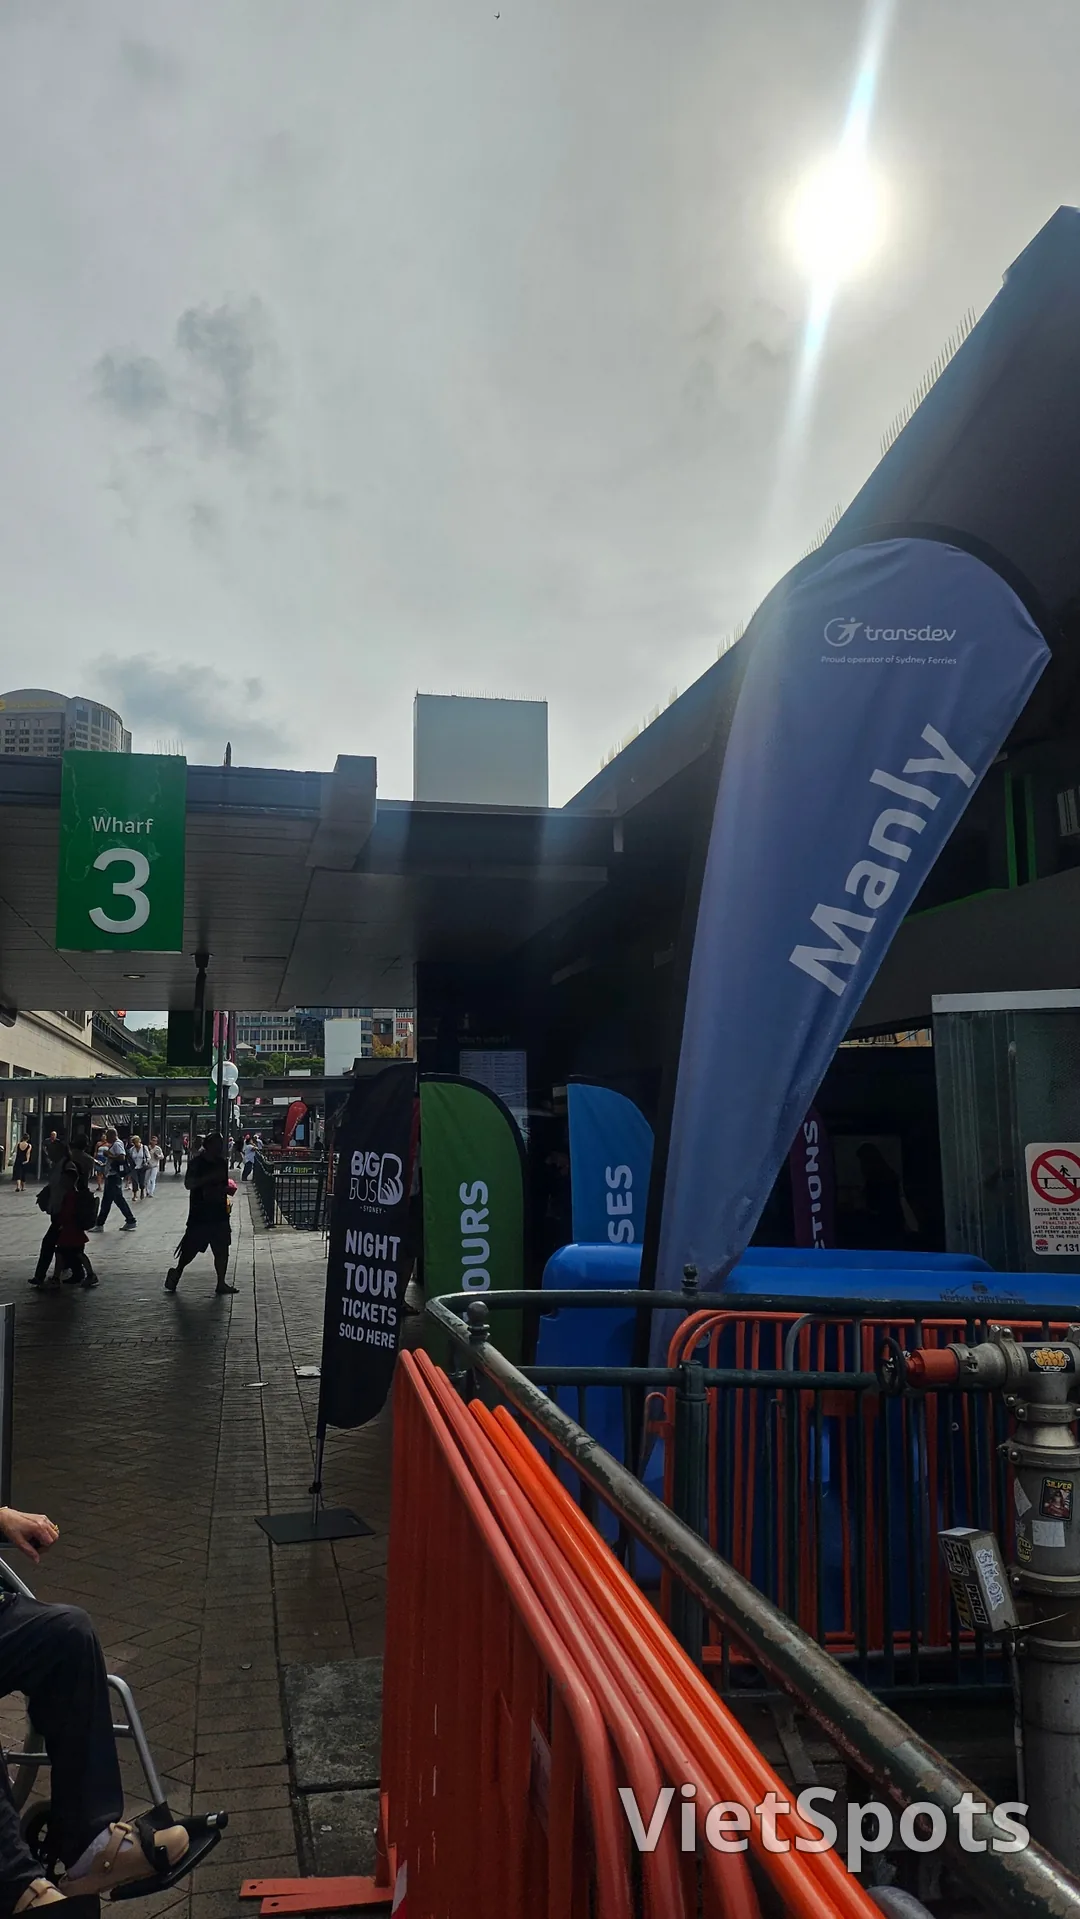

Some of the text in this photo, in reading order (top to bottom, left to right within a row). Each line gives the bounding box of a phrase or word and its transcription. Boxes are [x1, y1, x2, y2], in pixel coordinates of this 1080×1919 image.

[864, 625, 957, 641] transdev
[847, 656, 884, 664] operator
[885, 655, 895, 663] of
[895, 656, 926, 665] Sydney
[928, 656, 957, 665] Ferries
[91, 815, 154, 834] Wharf
[788, 722, 977, 997] Manly
[88, 847, 151, 935] 3
[350, 1150, 380, 1177] BIG
[349, 1177, 378, 1203] BUS
[345, 1228, 401, 1262] NIGHT
[459, 1180, 491, 1320] OURS
[344, 1261, 398, 1300] TOUR
[341, 1297, 398, 1327] TICKETS
[338, 1322, 396, 1349] SOLD HERE
